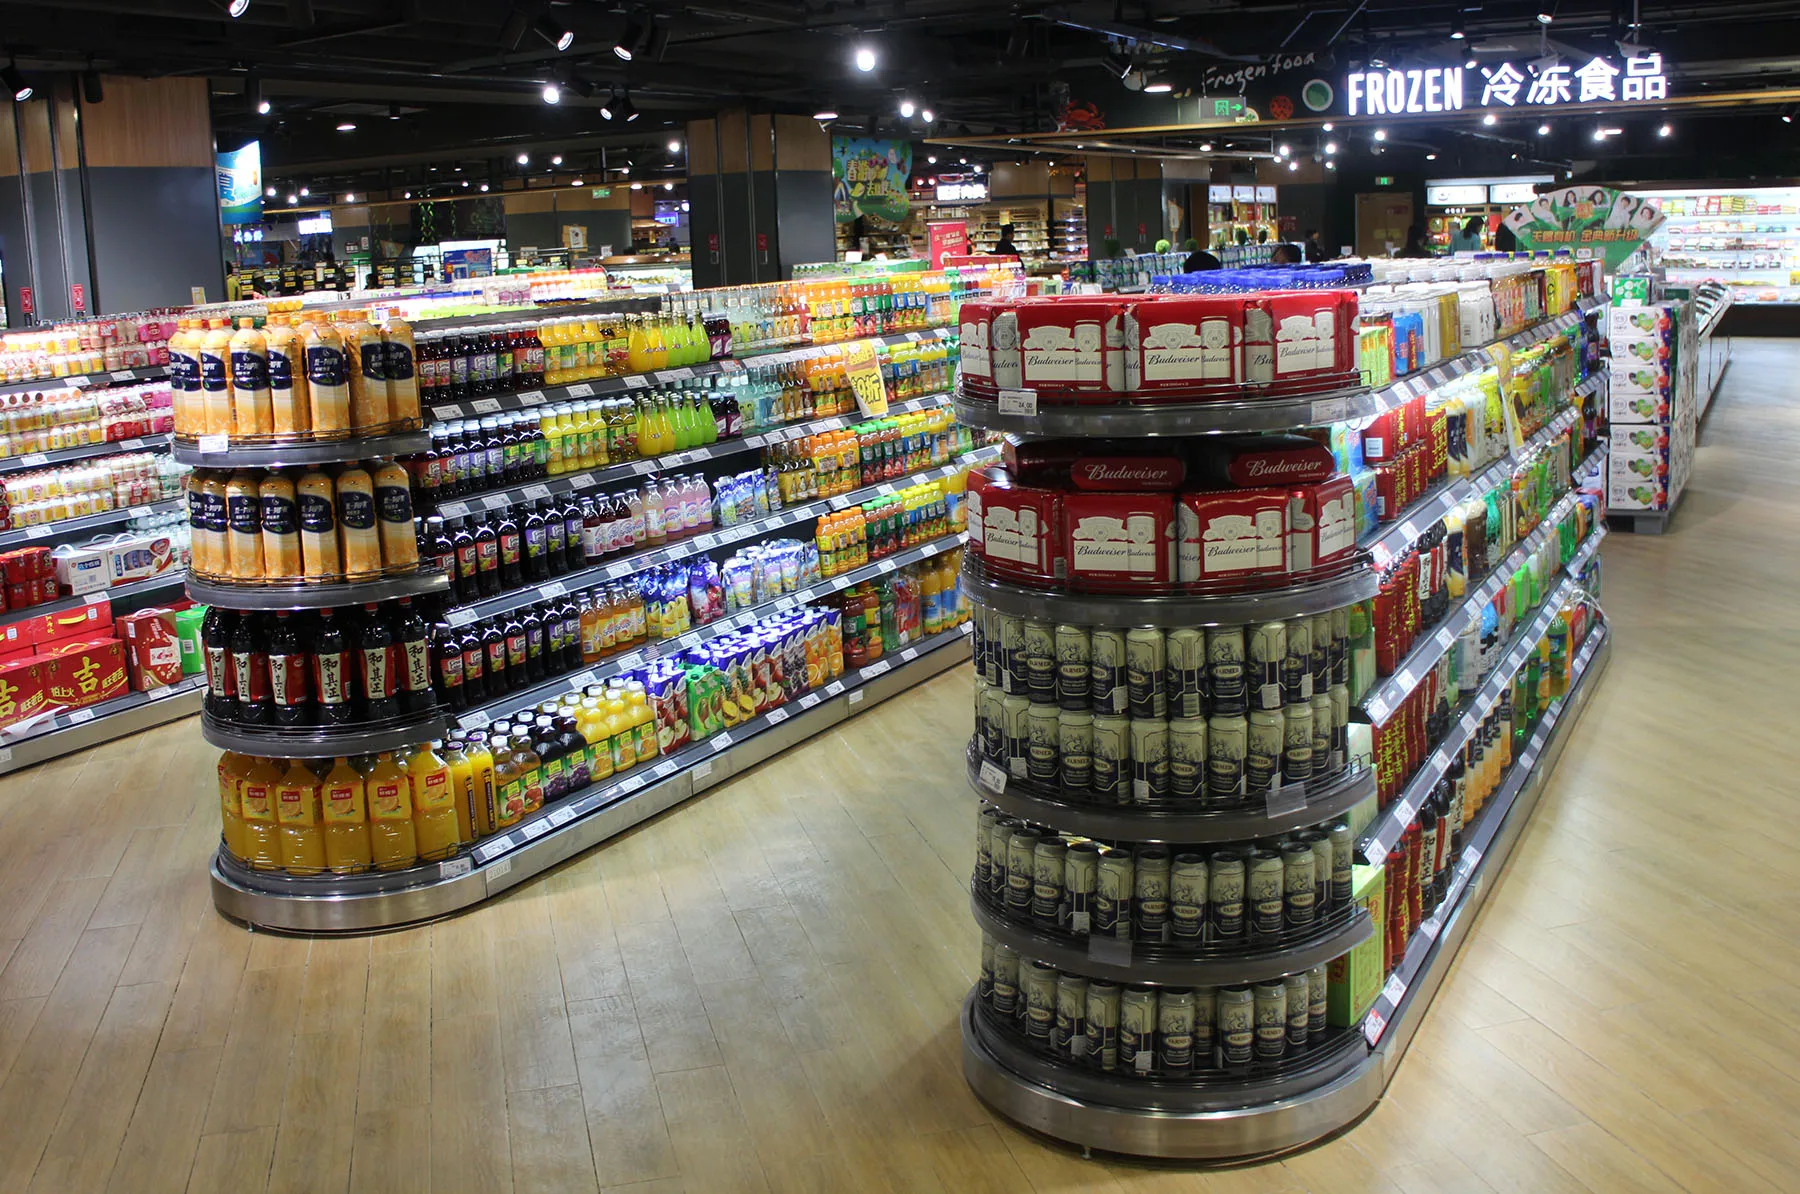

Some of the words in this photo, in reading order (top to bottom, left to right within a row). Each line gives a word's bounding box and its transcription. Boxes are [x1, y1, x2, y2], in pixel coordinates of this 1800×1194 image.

[1202, 64, 1266, 94] Frozen
[1480, 54, 1668, 107] 冷冻食品
[1348, 66, 1463, 116] FROZEN
[1026, 355, 1074, 367] Budweiser
[1147, 354, 1200, 366] Budweiser
[1280, 347, 1315, 358] Budweiser
[1085, 464, 1168, 481] Budweiser
[1246, 460, 1322, 477] Budweiser
[987, 532, 1019, 546] Budweiser
[1075, 545, 1128, 556] Budweiser
[1205, 545, 1257, 557] Budweiser
[367, 652, 384, 694] 和其正
[408, 644, 427, 687] 和其正
[73, 656, 101, 693] 吉
[322, 657, 341, 699] 和其正
[51, 687, 76, 699] 怕上火
